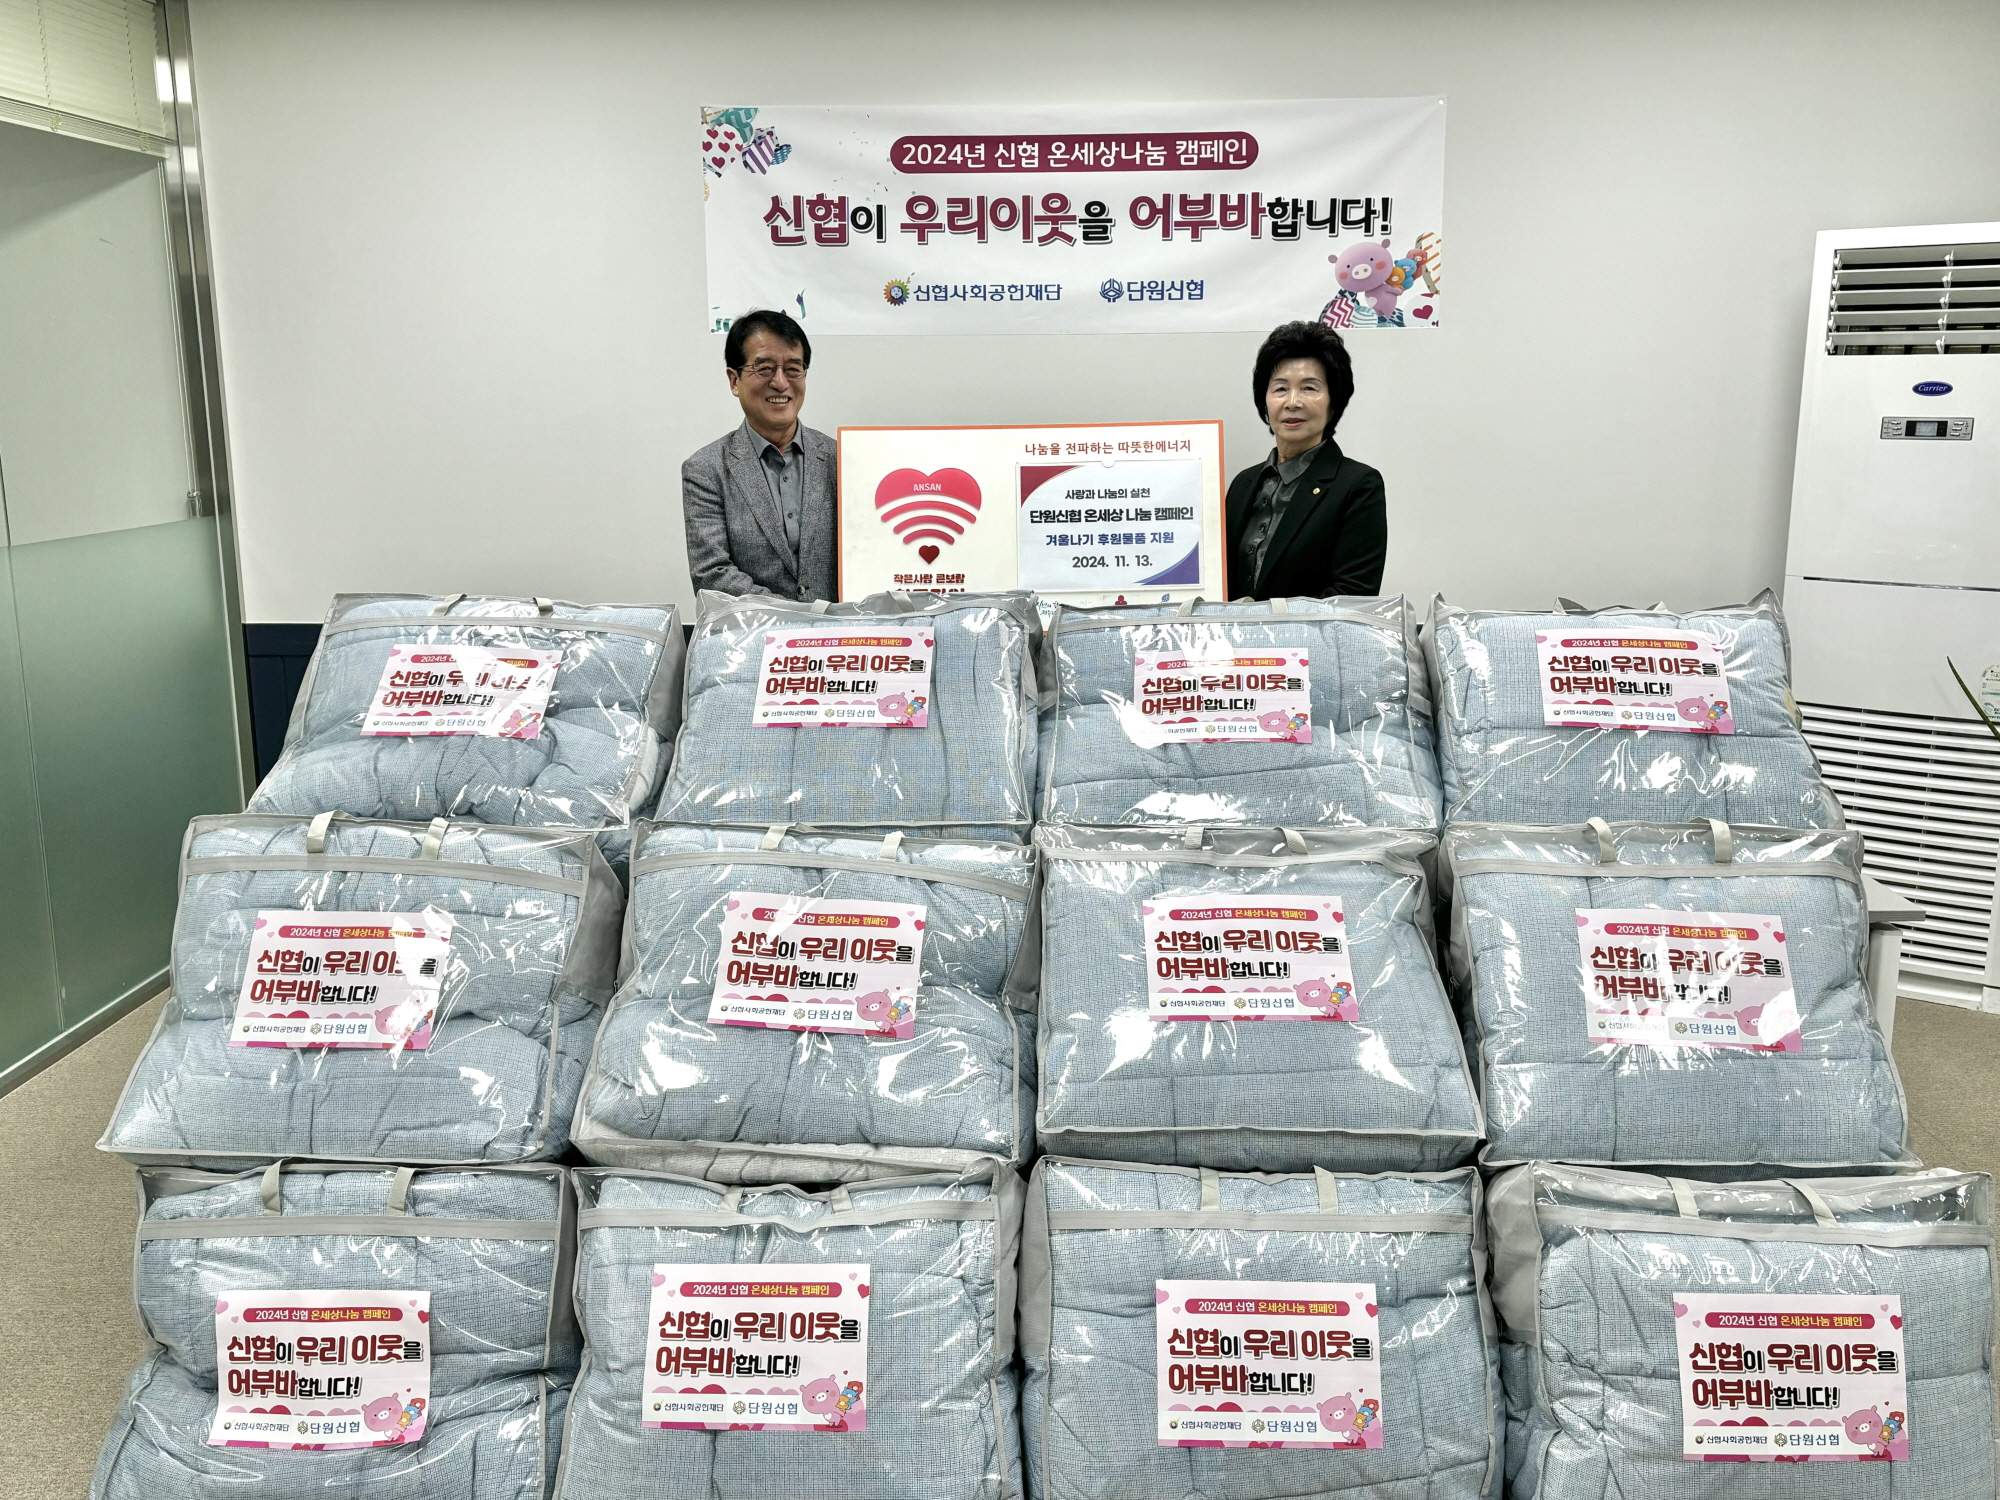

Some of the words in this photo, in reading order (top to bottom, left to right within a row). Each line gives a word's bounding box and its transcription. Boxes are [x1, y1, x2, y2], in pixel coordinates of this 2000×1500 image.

[902, 143, 985, 167] 2024년
[994, 143, 1039, 167] 신협
[1047, 141, 1167, 166] 온세상나눔
[1176, 139, 1248, 165] 캠페인
[764, 193, 886, 246] 신협이
[900, 192, 1113, 246] 우리이웃을
[1129, 192, 1392, 241] 어부바합니다!
[913, 281, 1063, 302] 신협사회공헌재단
[1127, 279, 1204, 301] 단원신협
[1025, 443, 1061, 455] 나눔을
[1066, 442, 1113, 455] 전파하는
[1118, 440, 1191, 453] 따뜻한에너지
[913, 483, 941, 492] ANSAN
[1065, 489, 1095, 499] 사랑과
[1098, 489, 1127, 499] 나눔의
[1130, 488, 1150, 498] 실천
[1030, 510, 1081, 523] 단원신협
[1084, 509, 1123, 522] 온세상
[1126, 508, 1151, 521] 나눔
[1154, 507, 1193, 520] 캠페인
[1046, 534, 1093, 546] 겨울나기
[1098, 533, 1146, 545] 후원물품
[1150, 532, 1174, 544] 지원
[1072, 556, 1109, 568] 2024.
[1115, 556, 1129, 567] 11.
[1135, 555, 1152, 566] 13.
[894, 574, 932, 584] 작은사랑
[936, 574, 965, 583] 큰보람
[880, 638, 902, 646] 캠페인
[1664, 641, 1687, 649] 캠페인
[421, 655, 447, 663] 2024년
[769, 656, 822, 673] 신협이
[827, 655, 866, 672] 우리
[871, 655, 924, 672] 이웃을
[1548, 656, 1607, 672] 신협이
[1611, 656, 1654, 673] 우리
[1659, 658, 1719, 675] 이웃을
[390, 670, 444, 687] 신협이
[765, 676, 876, 694] 어부바합니다!
[1142, 677, 1197, 694] 신협이
[1201, 674, 1242, 690] 우리
[1247, 674, 1301, 690] 이웃을
[1551, 676, 1671, 694] 어부바합니다!
[382, 690, 493, 706] 어부바합니다!
[1142, 695, 1254, 714] 어부바합니다!
[1563, 709, 1613, 717] 신협사회공헌재단
[1634, 711, 1676, 721] 단원신협
[447, 719, 487, 727] 단원신협
[1181, 910, 1212, 919] 2024년
[1215, 910, 1232, 918] 신협
[1235, 910, 1279, 918] 온세상나눔
[1281, 910, 1307, 919] 캠페인
[863, 917, 888, 926] 캠페인
[290, 928, 321, 937] 2024년
[324, 928, 340, 937] 신협
[343, 928, 384, 937] 온세상나눔
[1617, 925, 1649, 934] 2024년
[1652, 926, 1670, 935] 신협
[731, 931, 794, 958] 신협이
[799, 937, 845, 960] 우리
[851, 939, 913, 962] 이웃을
[1155, 931, 1218, 951] 신협이
[1223, 929, 1270, 951] 우리
[1275, 931, 1340, 952] 이웃을
[257, 950, 319, 974] 신협이
[323, 951, 367, 974] 우리
[1591, 946, 1656, 969] 신협이
[1157, 957, 1288, 978] 어부바합니다!
[727, 961, 856, 988] 어부바합니다!
[250, 979, 377, 1004] 어부바합니다!
[1248, 998, 1295, 1008] 단원신협
[730, 1006, 786, 1016] 신협사회공헌재단
[807, 1010, 852, 1020] 단원신협
[252, 1025, 306, 1033] 신협사회공헌재단
[324, 1024, 367, 1034] 단원신협
[1689, 1023, 1736, 1035] 단원신협
[693, 1285, 727, 1295] 2024년
[730, 1285, 748, 1295] 신협
[751, 1285, 798, 1295] 온세상나눔
[801, 1285, 829, 1295] 캠페인
[1198, 1302, 1232, 1312] 2024년
[1235, 1303, 1254, 1312] 신협
[1258, 1303, 1305, 1313] 온세상나눔
[1308, 1304, 1337, 1313] 캠페인
[256, 1311, 289, 1319] 2024년
[292, 1311, 309, 1320] 신협
[311, 1310, 359, 1320] 온세상나눔
[363, 1310, 390, 1319] 캠페인
[1719, 1316, 1754, 1325] 2024년
[1758, 1316, 1777, 1326] 신협
[1780, 1316, 1830, 1326] 온세상나눔
[1833, 1317, 1862, 1327] 캠페인
[659, 1311, 728, 1339] 신협이
[734, 1312, 783, 1339] 우리
[790, 1312, 859, 1339] 이웃을
[227, 1336, 291, 1361] 신협이
[296, 1336, 345, 1362] 우리
[352, 1335, 421, 1360] 이웃을
[1168, 1328, 1238, 1356] 신협이
[1244, 1329, 1294, 1357] 우리
[1301, 1330, 1371, 1357] 이웃을
[656, 1347, 798, 1375] 어부바합니다!
[1689, 1342, 1762, 1371] 신협이
[1768, 1344, 1819, 1371] 우리
[1827, 1344, 1897, 1371] 이웃을
[228, 1369, 359, 1397] 어부바합니다!
[1169, 1364, 1312, 1393] 어부바합니다!
[1693, 1379, 1837, 1407] 어부바합니다!
[664, 1403, 724, 1412] 신협사회공헌재단
[749, 1402, 798, 1415] 단원신협
[234, 1423, 289, 1432] 신협사회공헌재단
[311, 1421, 360, 1434] 단원신협
[1181, 1420, 1242, 1430] 신협사회공헌재단
[1268, 1420, 1317, 1432] 단원신협
[1707, 1435, 1767, 1444] 신협사회공헌재단
[1790, 1434, 1839, 1446] 단원신협
